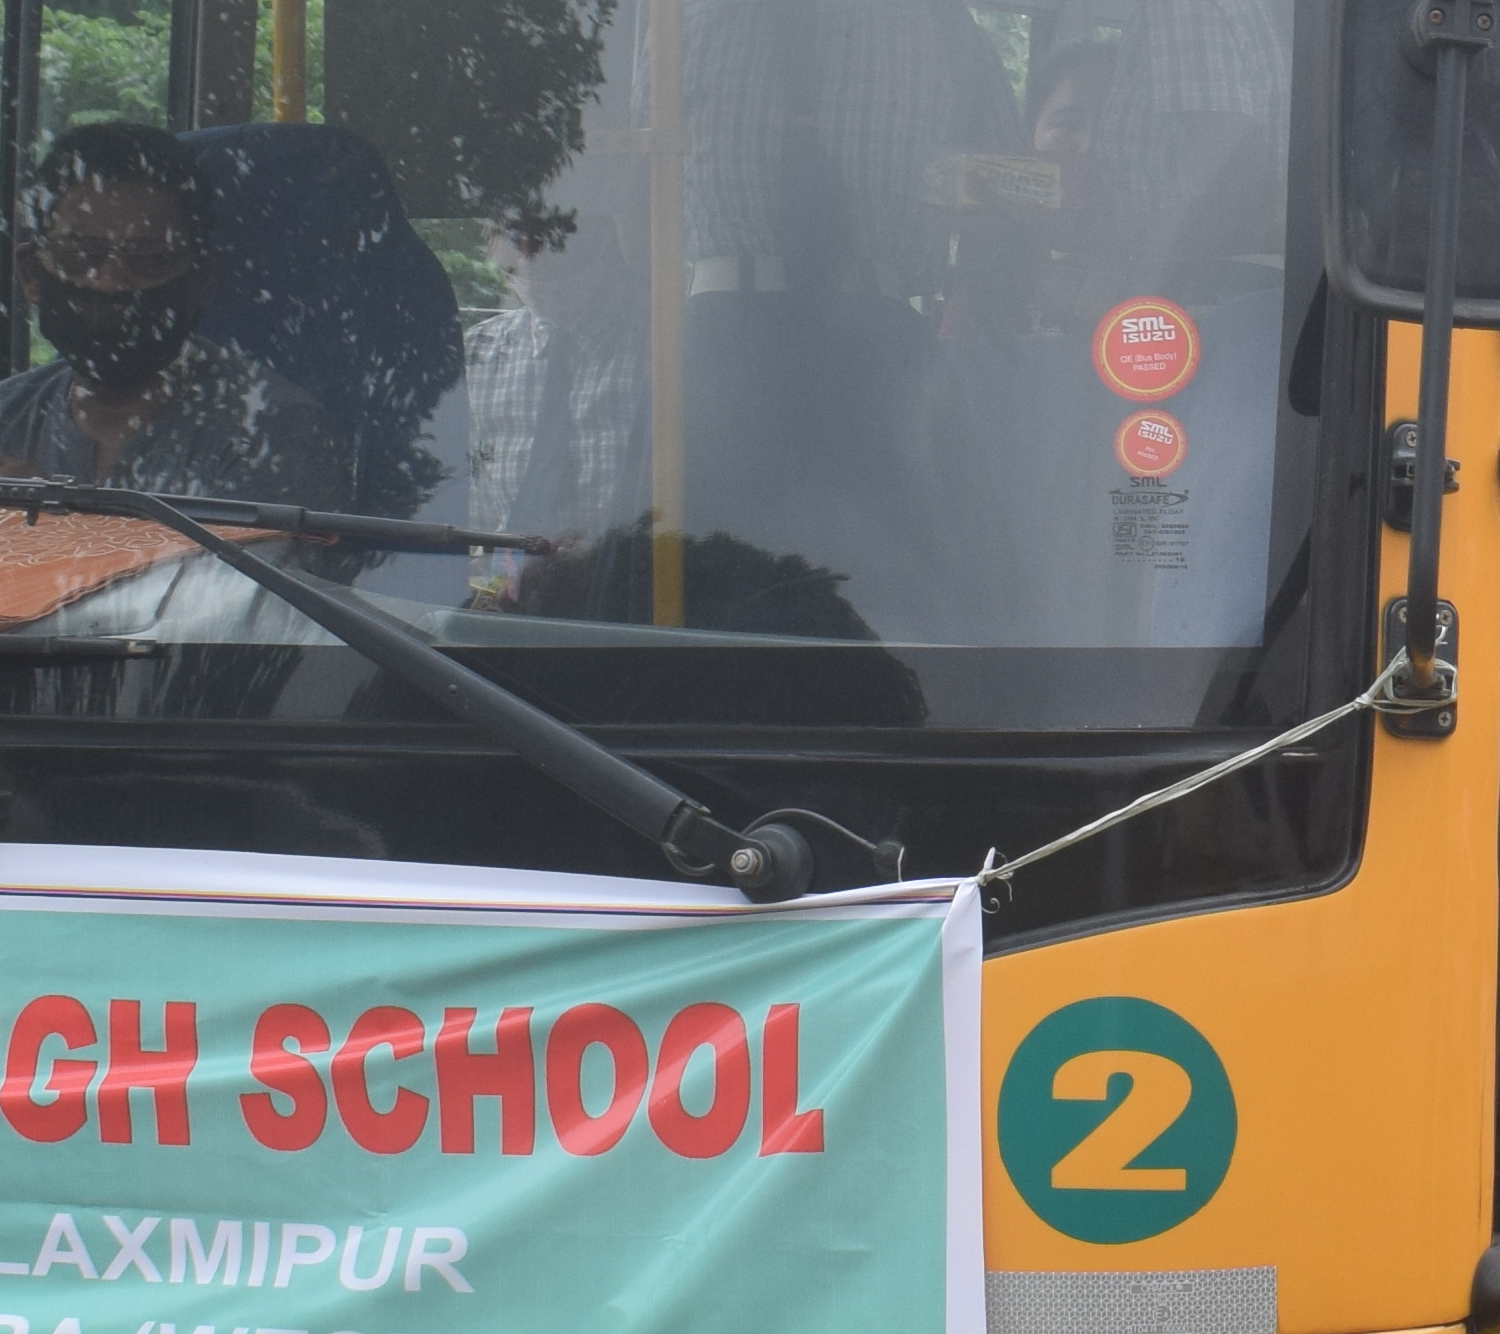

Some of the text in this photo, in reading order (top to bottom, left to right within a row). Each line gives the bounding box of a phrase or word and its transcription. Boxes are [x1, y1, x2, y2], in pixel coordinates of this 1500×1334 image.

[1121, 316, 1175, 333] SML
[1122, 330, 1176, 344] ISUZU
[1137, 428, 1173, 445] ISUZU
[1140, 420, 1174, 438] SML
[1130, 476, 1167, 487] SML
[239, 1002, 825, 1160] SCHOOL
[1051, 1048, 1193, 1192] 2
